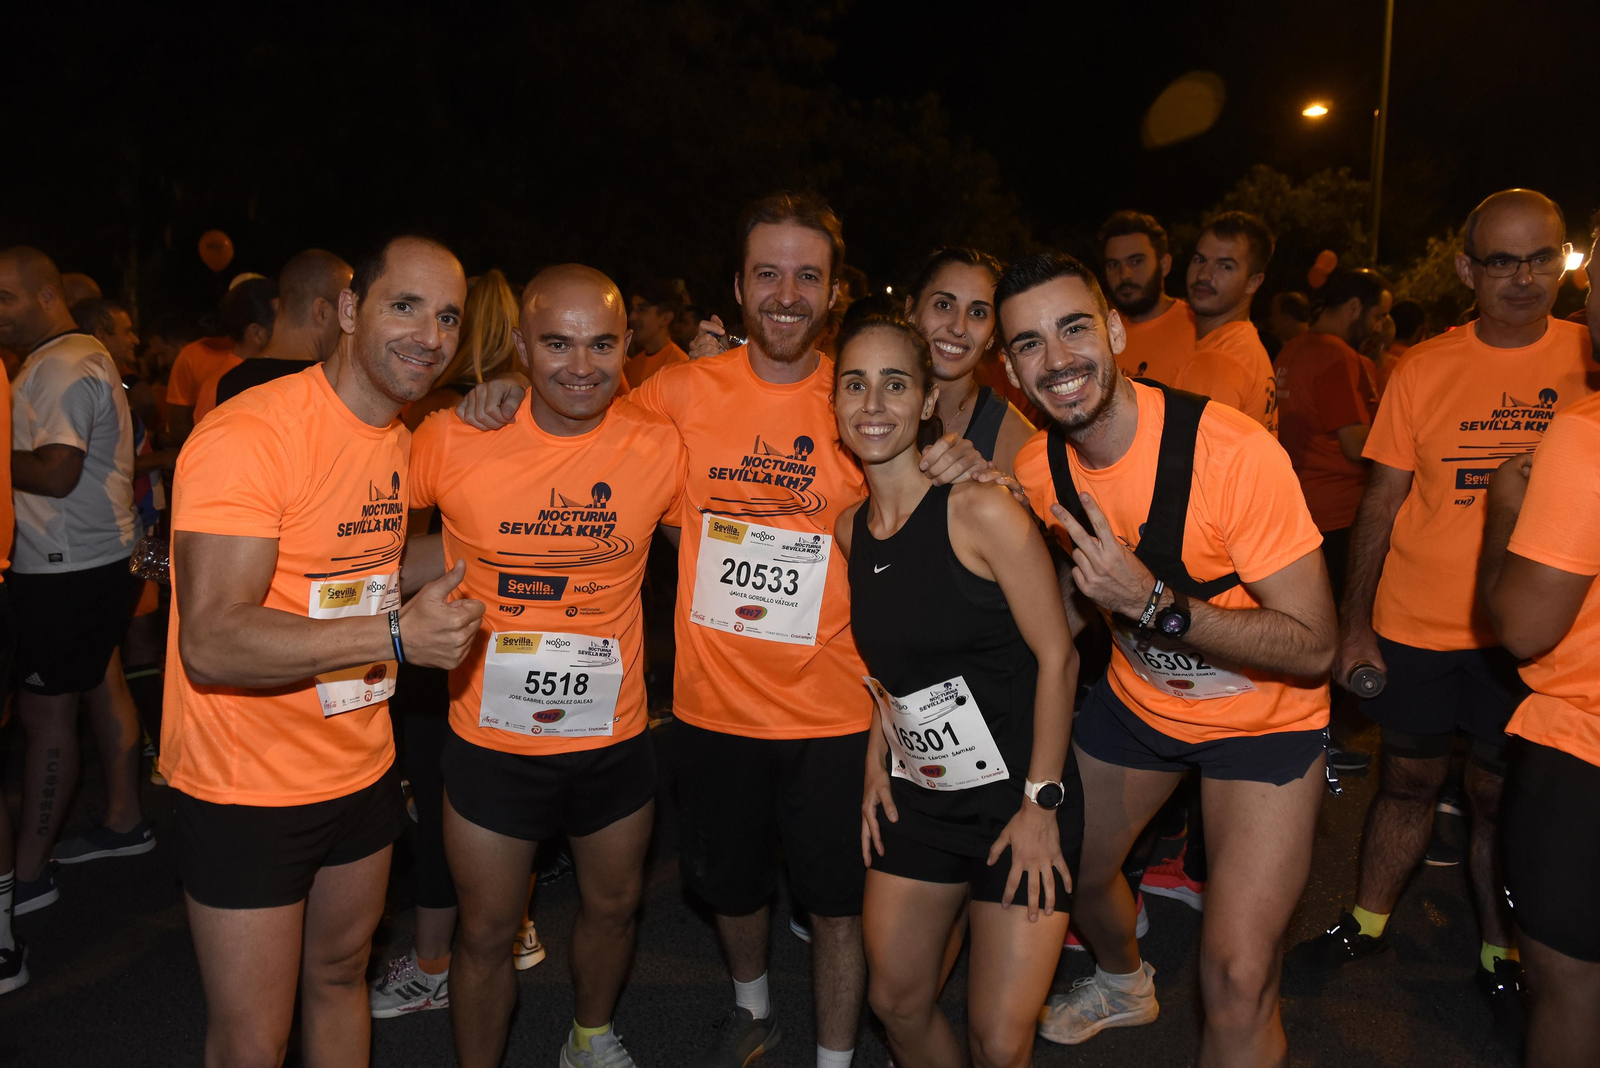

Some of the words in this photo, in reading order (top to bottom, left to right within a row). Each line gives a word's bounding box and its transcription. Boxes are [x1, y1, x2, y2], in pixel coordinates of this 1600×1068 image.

[1491, 409, 1555, 420] NOCTURN
[1459, 421, 1521, 431] SEVILLA
[1524, 421, 1548, 431] KH
[741, 456, 816, 477] NOCTURNA
[708, 467, 772, 485] SEVILLA
[1465, 473, 1490, 483] Sevil
[362, 503, 403, 517] NOCTURNA
[538, 510, 617, 522] NOCTURNA
[337, 520, 380, 537] SEVILLA
[499, 522, 573, 536] SEVILLA
[782, 545, 806, 553] SEVILLA
[720, 558, 799, 596] 20533
[748, 595, 774, 603] GORDILLO
[1133, 649, 1211, 671] 16302
[524, 671, 589, 696] 5518
[930, 689, 958, 702] NOCTURNA
[919, 699, 944, 712] SEVILLA
[893, 721, 960, 753] 16301
[952, 746, 976, 757] SANTIAGO
